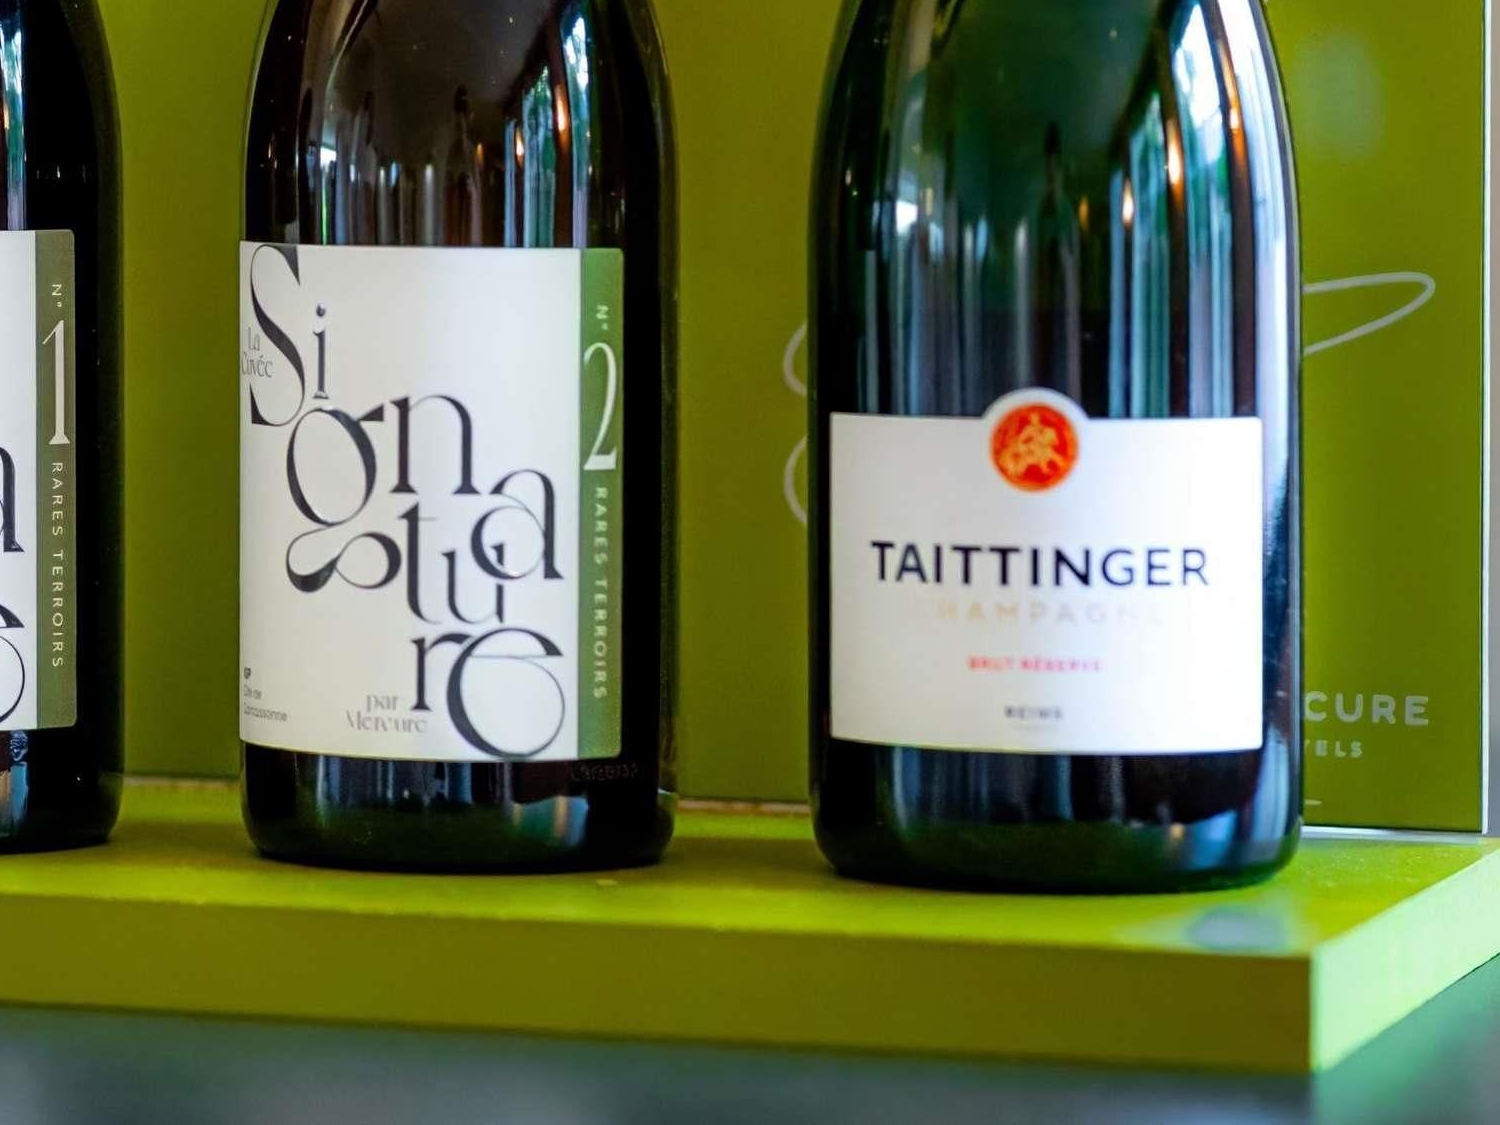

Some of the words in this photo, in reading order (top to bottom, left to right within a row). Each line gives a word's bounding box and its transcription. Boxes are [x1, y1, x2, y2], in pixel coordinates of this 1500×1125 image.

[43, 319, 71, 445] 1
[583, 342, 618, 471] 2
[51, 461, 63, 537] RARES
[595, 487, 608, 565] RARES
[871, 541, 1209, 587] TAITTINGER
[51, 549, 63, 668] TERROIRS
[594, 579, 608, 699] TERROIRS
[366, 694, 399, 713] par
[1304, 739, 1363, 758] ELS
